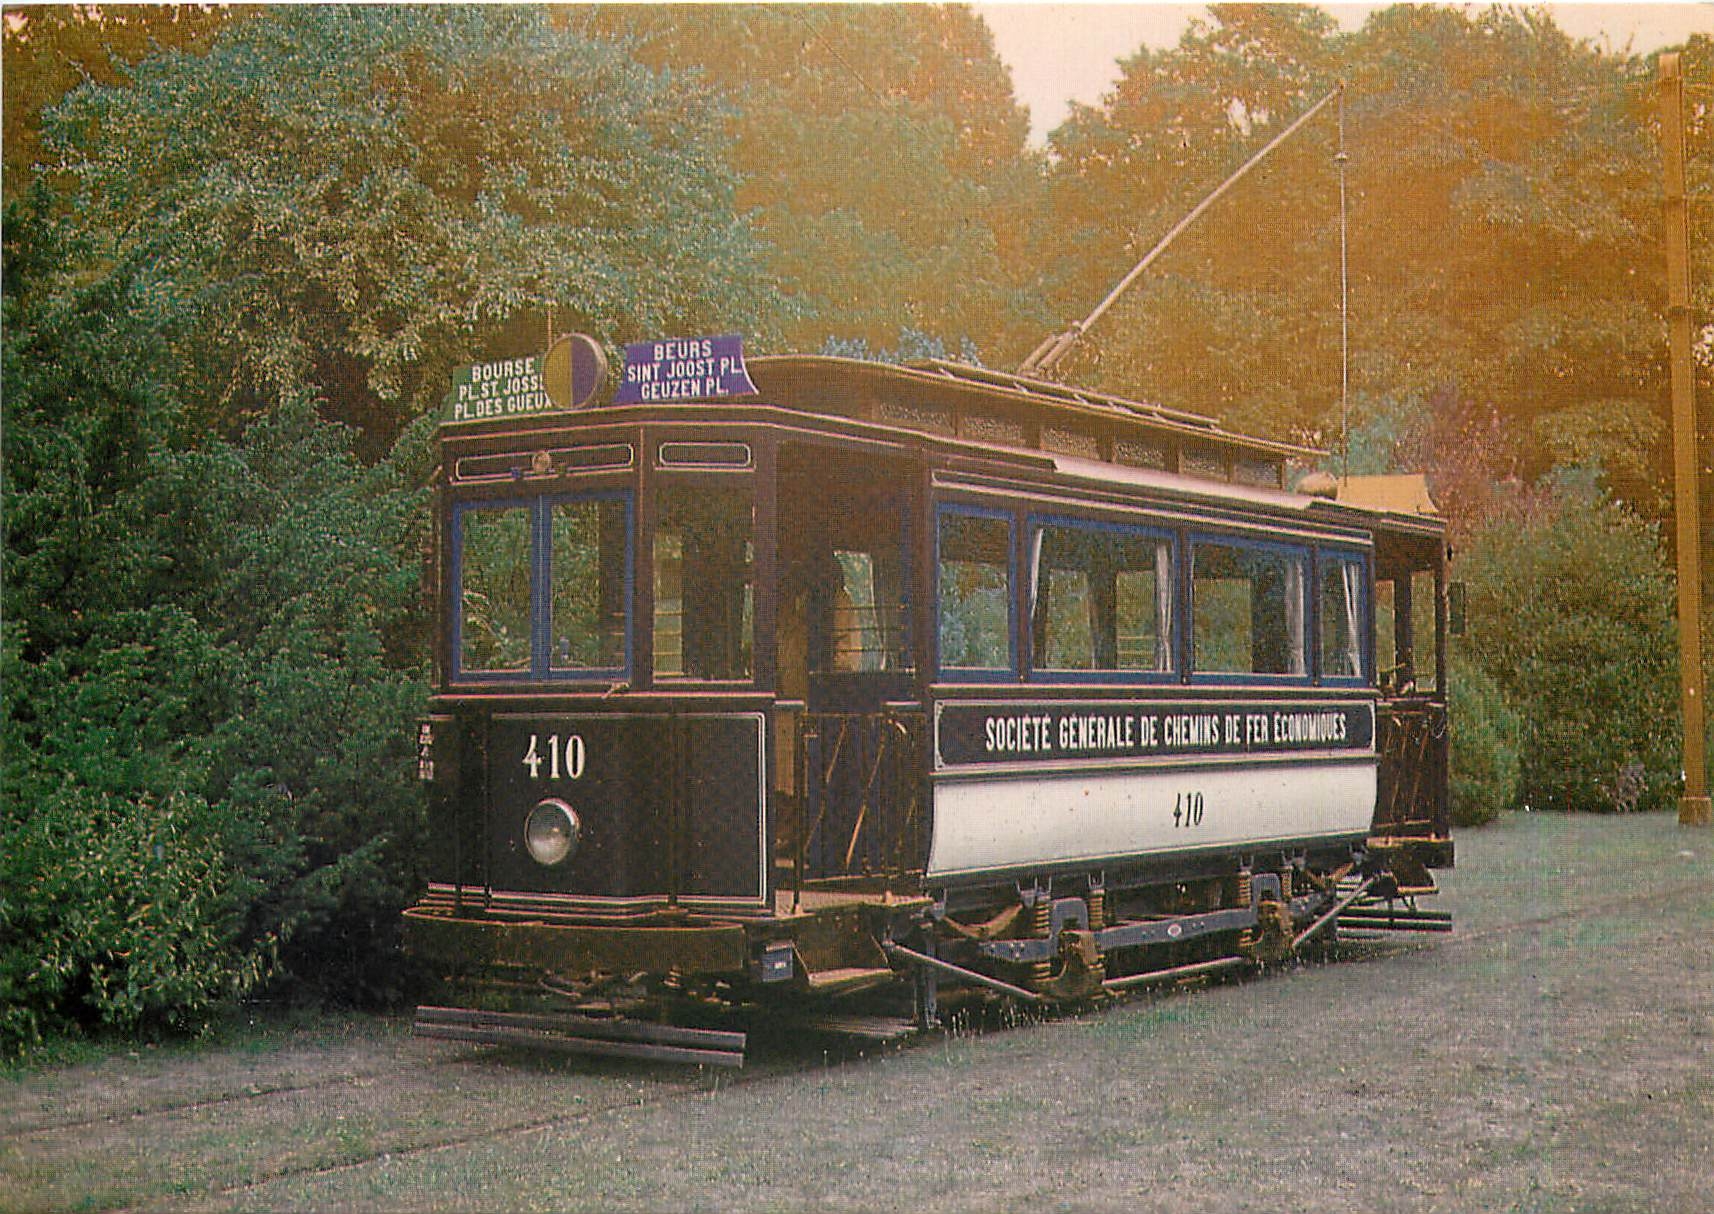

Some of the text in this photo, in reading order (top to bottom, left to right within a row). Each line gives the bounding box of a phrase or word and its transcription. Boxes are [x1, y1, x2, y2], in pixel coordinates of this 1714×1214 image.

[653, 339, 712, 361] BEURS
[471, 357, 535, 382] BOURSE
[627, 362, 661, 382] SINT
[666, 358, 715, 378] JOOST
[641, 376, 729, 400] GEUZEN PL.
[507, 392, 552, 413] GUEUX
[985, 713, 1051, 752] SOCIÉTÉ
[1059, 712, 1135, 749] GÉNÉRALE
[1140, 715, 1159, 746] DE
[1164, 714, 1219, 746] CHEMINS
[1225, 714, 1241, 744] DE
[1246, 714, 1269, 745] FER
[522, 734, 586, 779] 410
[1172, 791, 1204, 828] 410
